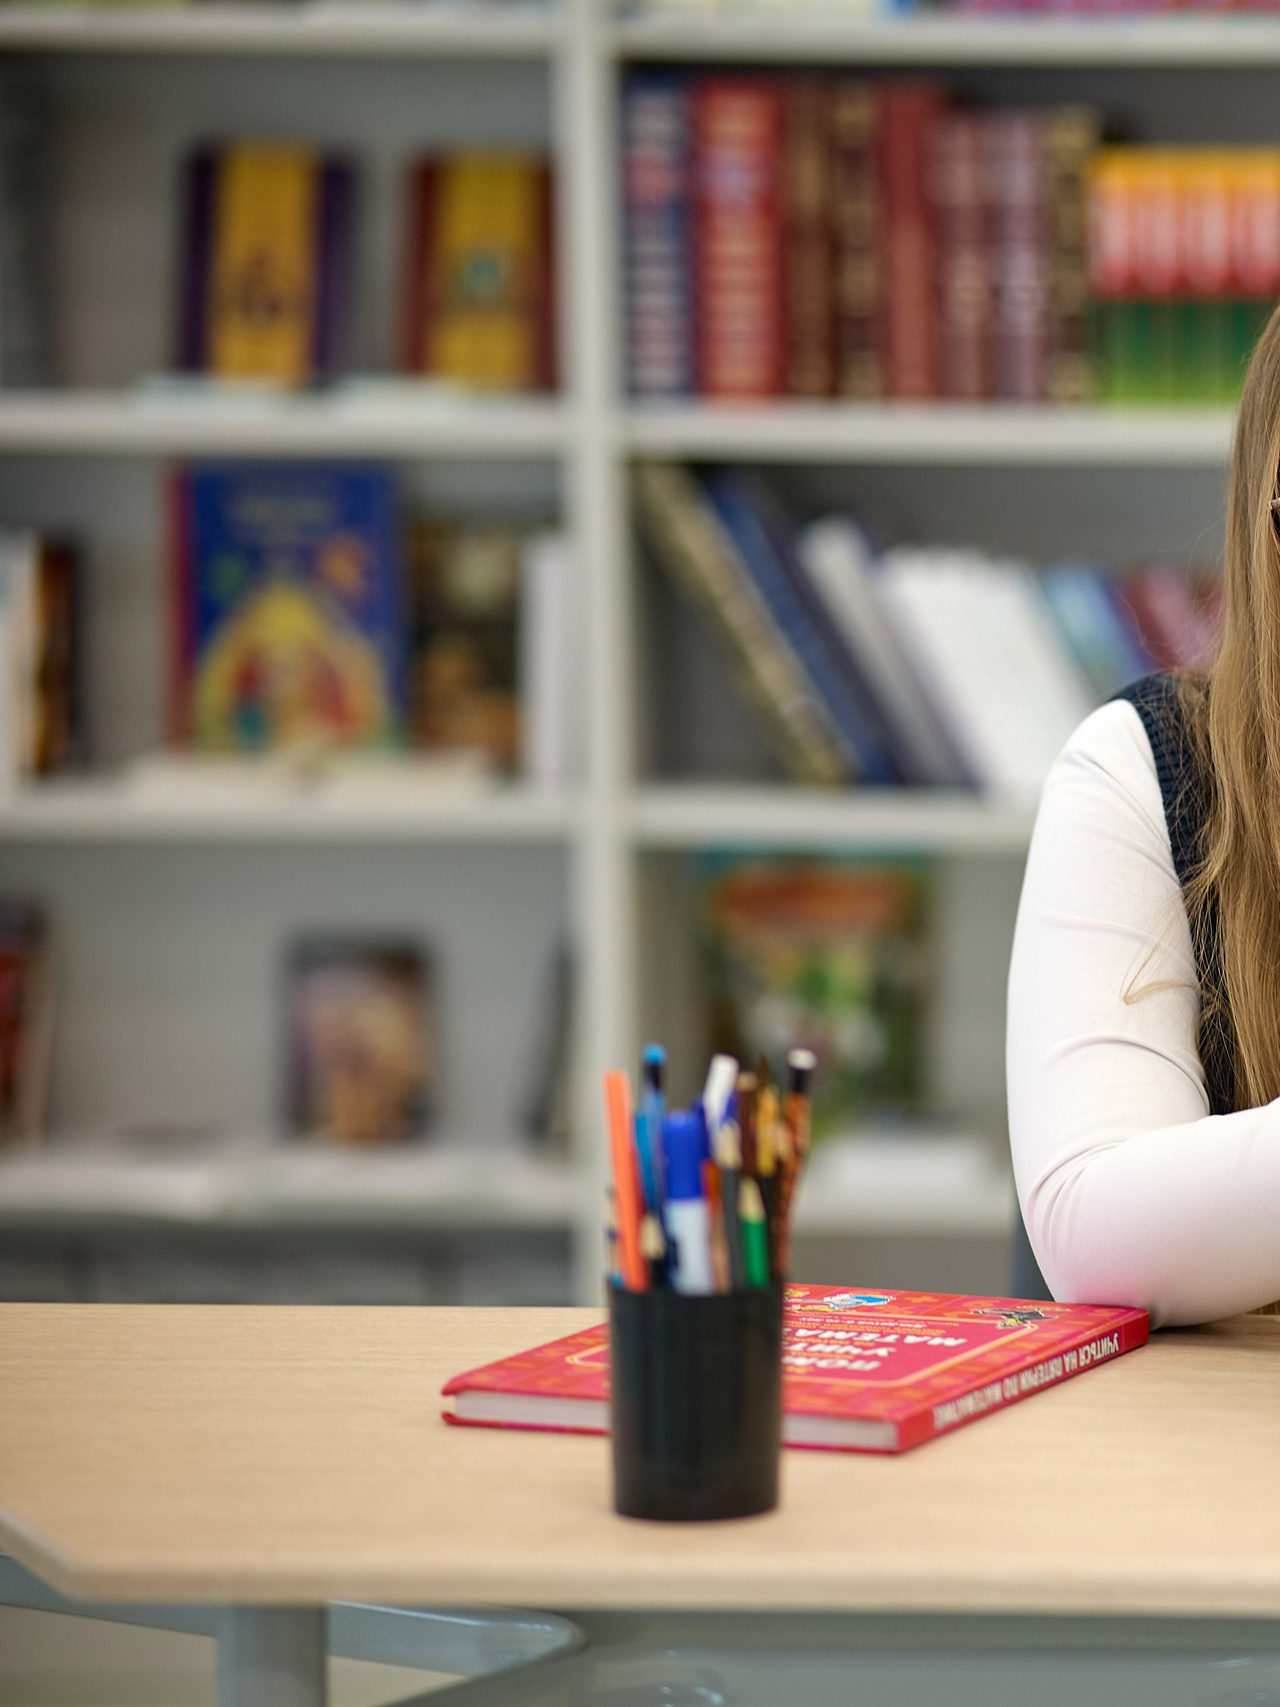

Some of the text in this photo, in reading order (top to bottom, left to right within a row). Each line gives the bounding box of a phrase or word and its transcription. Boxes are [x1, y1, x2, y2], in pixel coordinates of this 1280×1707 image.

[783, 1328, 967, 1347] МАТЕМА
[782, 1341, 897, 1358] УЧИТ
[1079, 1332, 1120, 1367] УЧИТЬСЯ
[781, 1356, 882, 1371] ПОМ
[1063, 1349, 1078, 1373] НА
[1003, 1374, 1019, 1400] ПО
